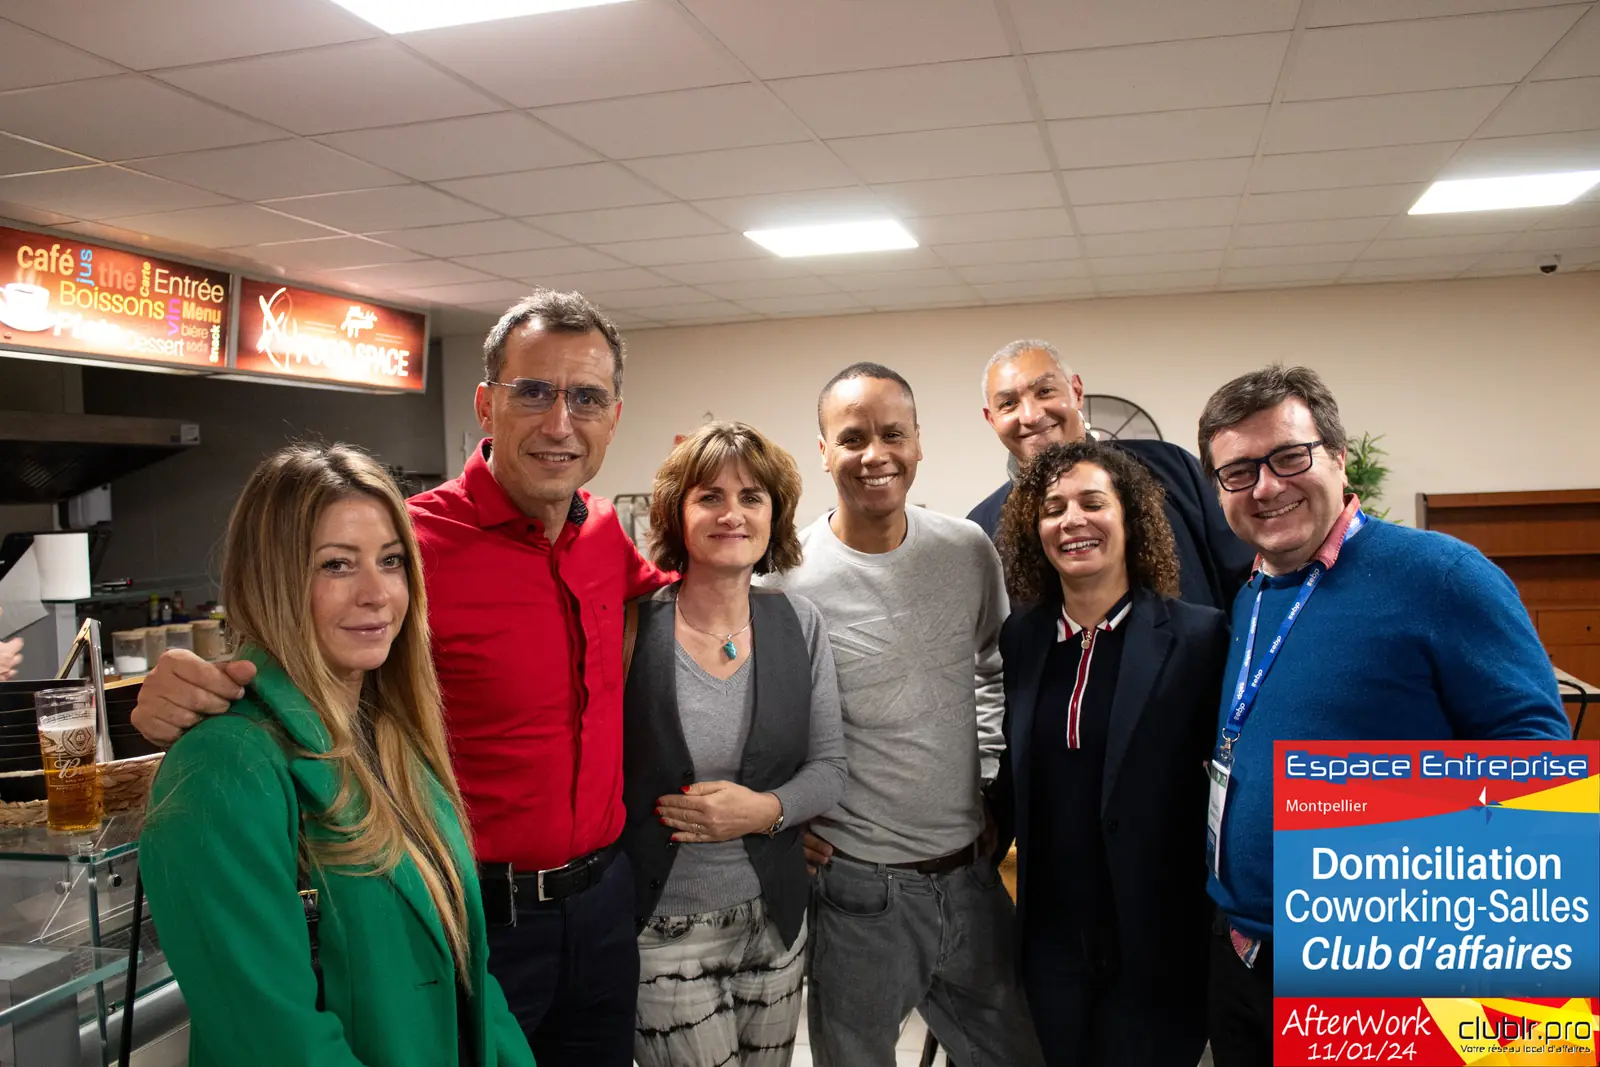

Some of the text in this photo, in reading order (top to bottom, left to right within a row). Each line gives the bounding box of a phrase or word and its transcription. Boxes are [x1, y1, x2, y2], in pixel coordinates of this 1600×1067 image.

[17, 244, 75, 276] café
[75, 249, 95, 287] jus
[97, 261, 137, 292] thé
[60, 280, 165, 320] Boissons
[154, 268, 224, 303] Entrée
[166, 298, 181, 336] vin
[182, 300, 222, 324] Menu
[125, 331, 184, 357] Dessert
[355, 343, 409, 377] SPACE
